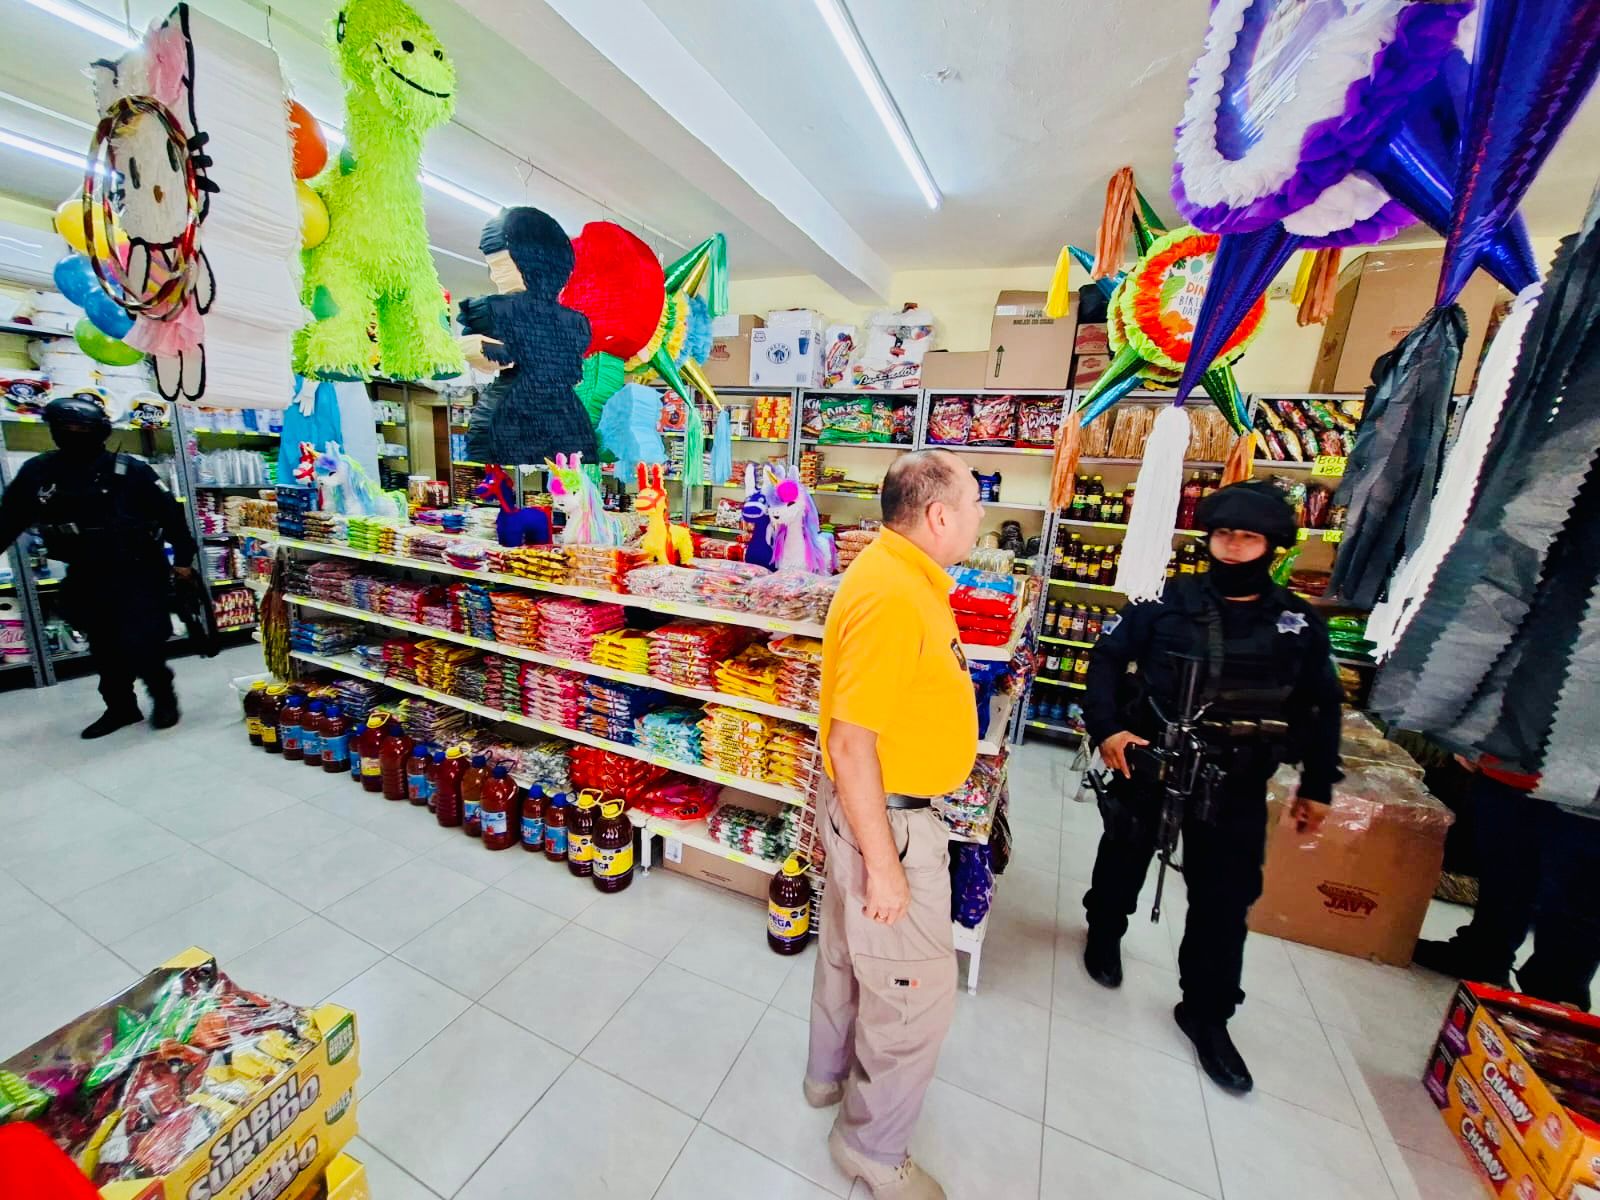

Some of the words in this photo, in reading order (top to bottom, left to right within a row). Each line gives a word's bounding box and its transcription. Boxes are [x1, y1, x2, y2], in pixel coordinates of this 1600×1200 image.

[1179, 296, 1203, 307] BIRT
[1186, 281, 1205, 296] DIN
[187, 1074, 320, 1200] SURTIDO
[209, 1072, 300, 1166] SABRI
